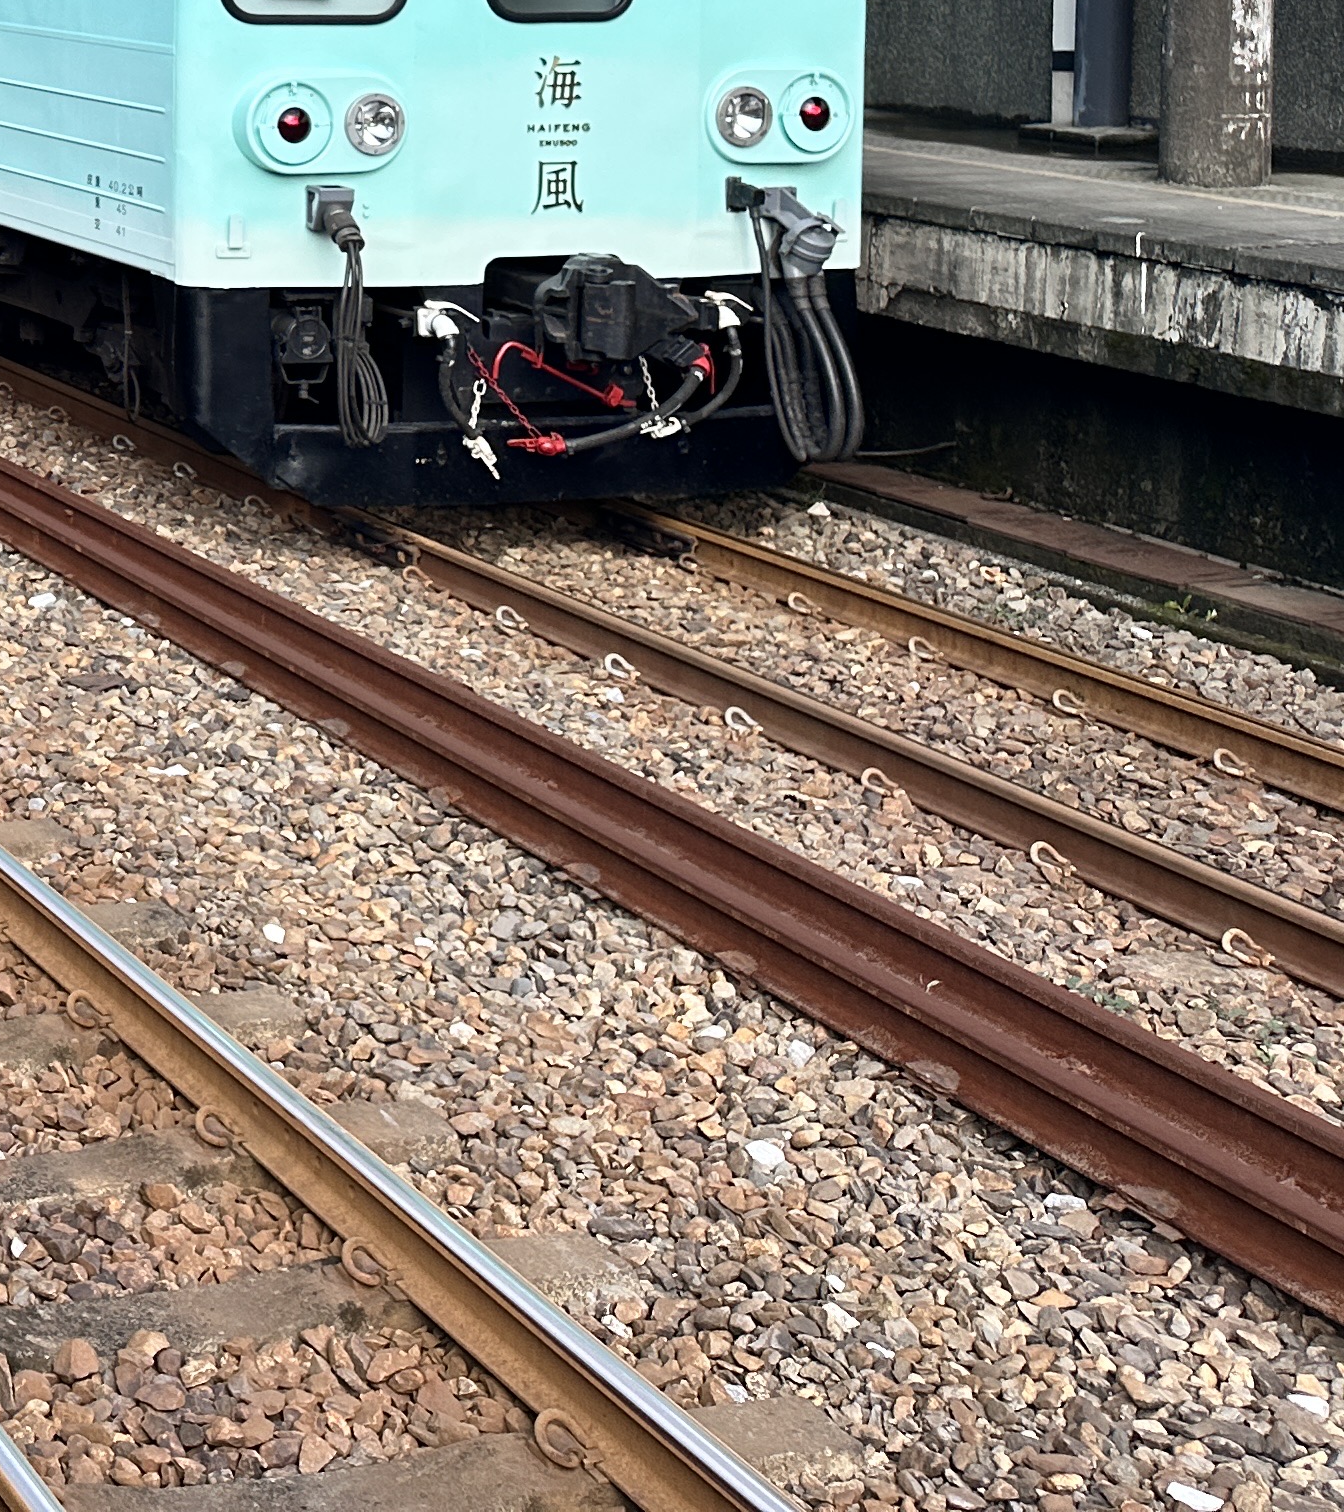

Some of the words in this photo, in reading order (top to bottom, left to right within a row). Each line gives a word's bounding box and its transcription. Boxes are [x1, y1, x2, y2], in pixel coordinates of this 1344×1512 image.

[534, 55, 582, 109] 海
[526, 123, 591, 133] HAIFENG
[530, 160, 584, 215] 風
